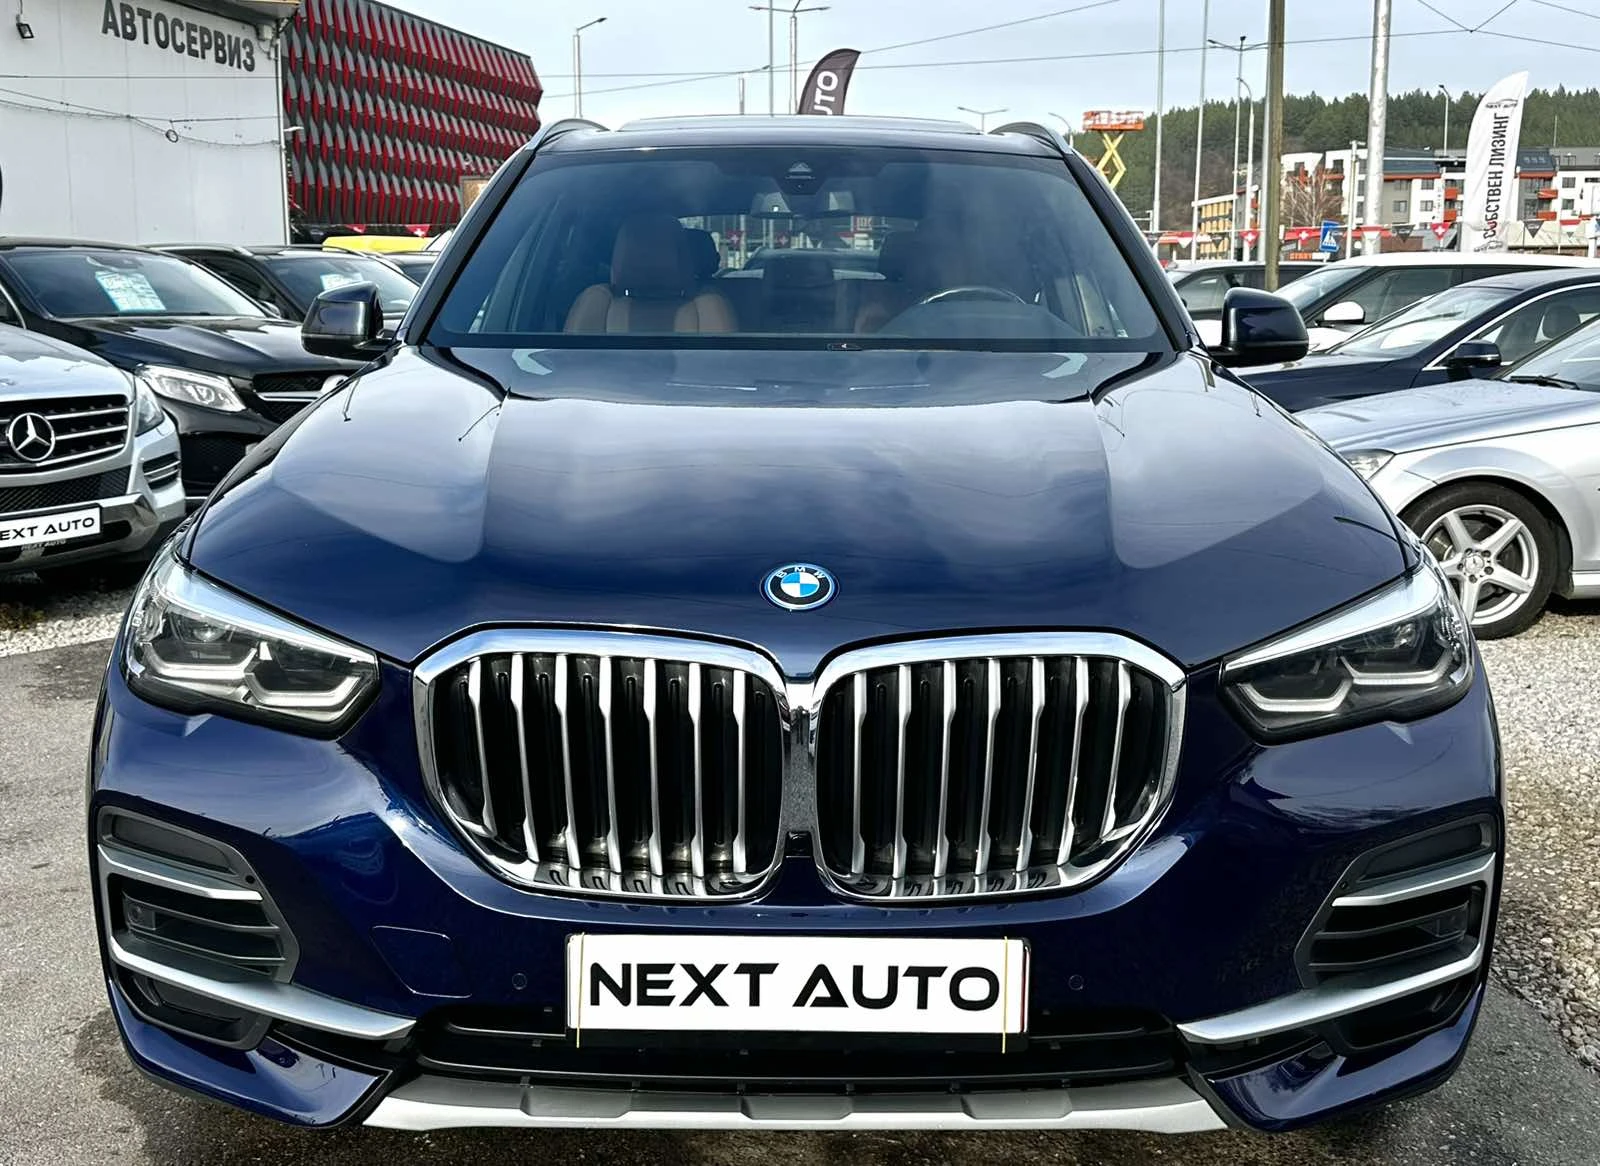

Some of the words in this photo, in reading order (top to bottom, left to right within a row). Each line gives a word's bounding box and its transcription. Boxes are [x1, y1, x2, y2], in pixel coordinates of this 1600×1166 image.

[102, 0, 255, 72] АВТОСЕРВИЗ
[814, 71, 839, 115] UTO
[1489, 112, 1510, 167] ЛИЗИНГ
[0, 525, 38, 540] EXT
[43, 517, 95, 535] AUTO
[776, 566, 826, 579] BMW
[590, 962, 779, 1007] NEXT
[792, 963, 1000, 1011] AUTO
